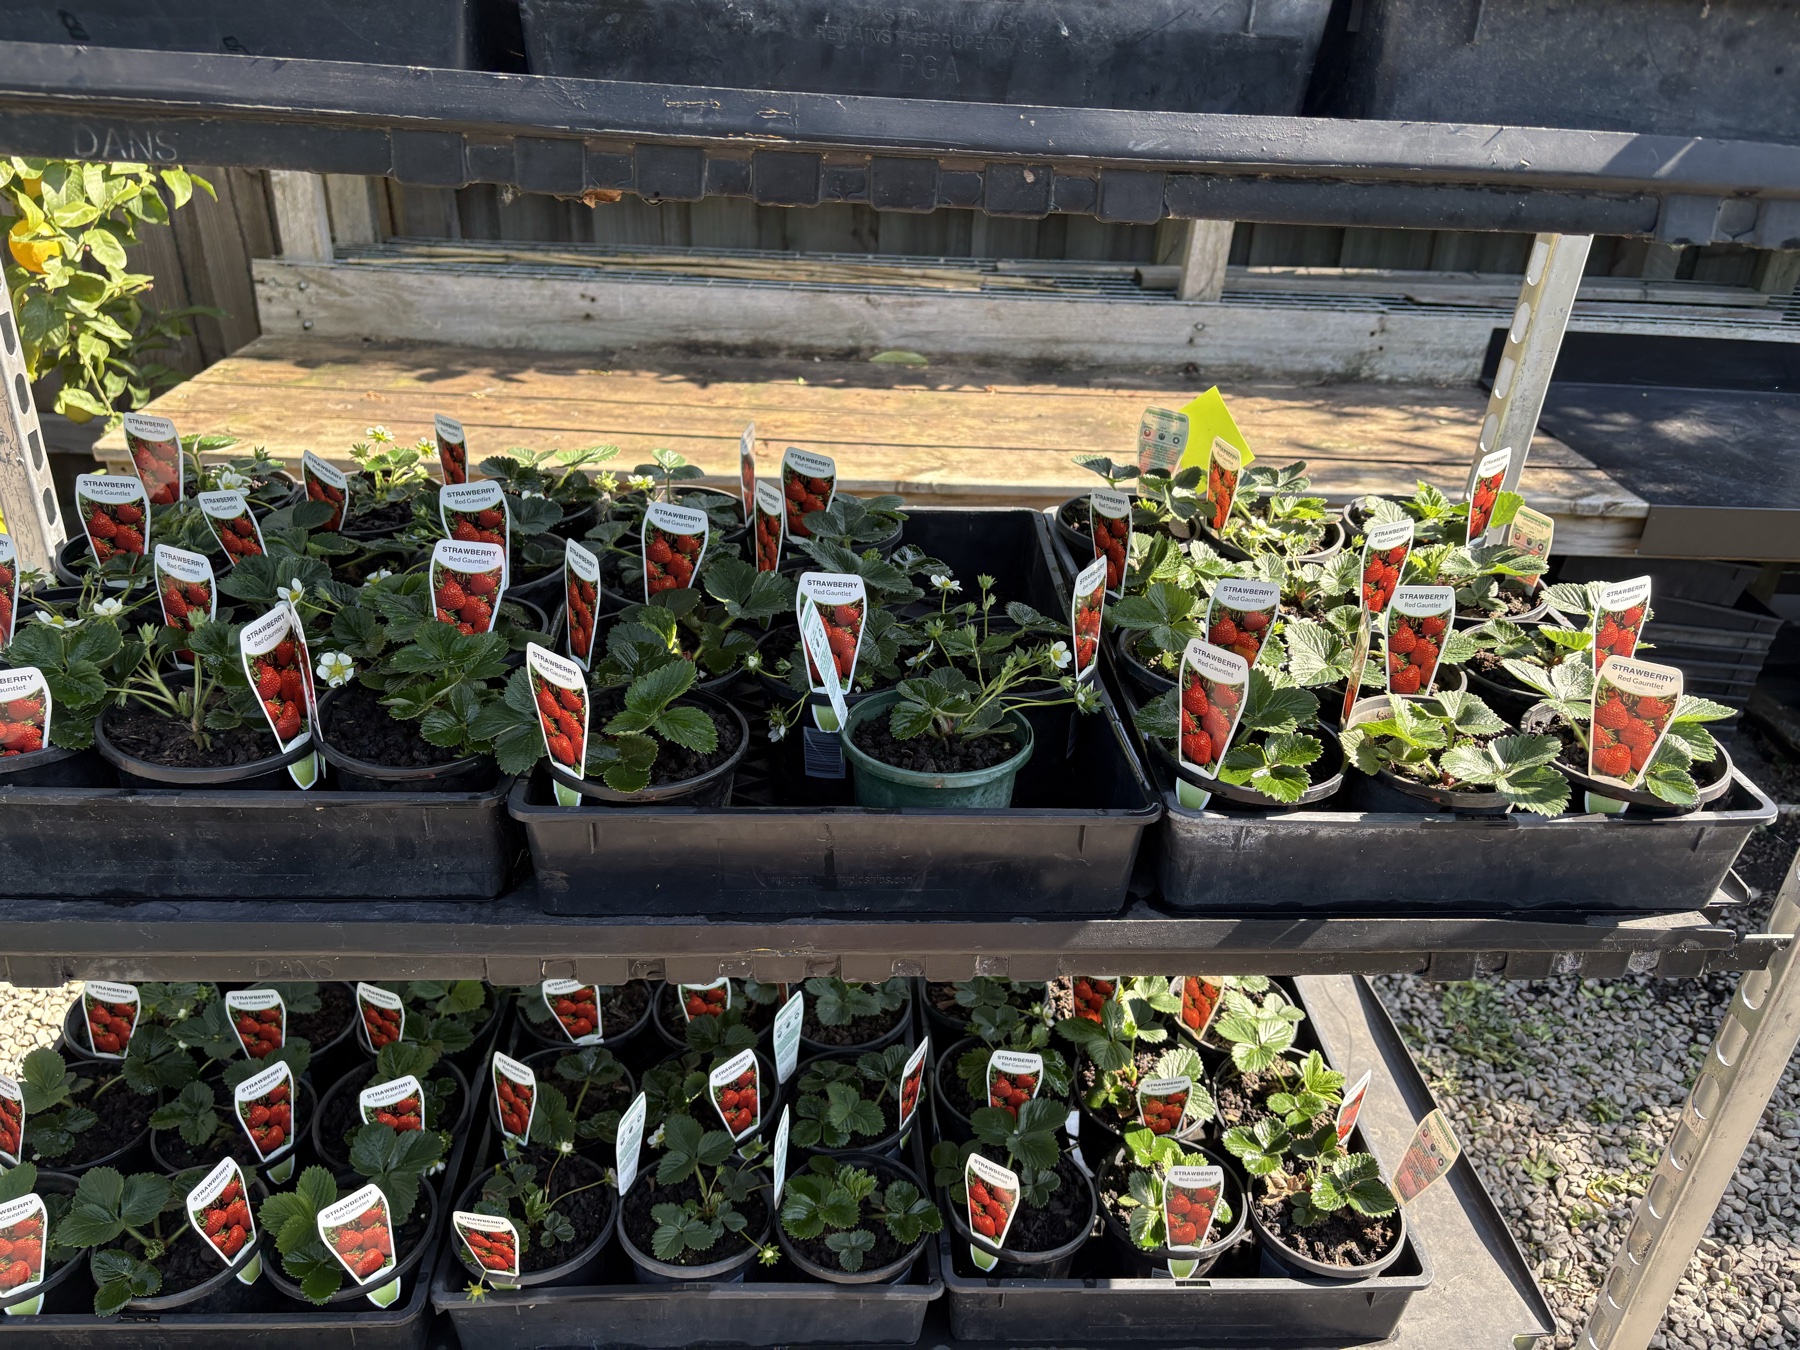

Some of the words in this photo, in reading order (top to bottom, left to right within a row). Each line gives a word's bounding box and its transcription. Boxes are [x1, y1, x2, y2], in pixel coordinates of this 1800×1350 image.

[814, 24, 893, 44] REMAINS
[932, 31, 1017, 51] PROPERTY
[900, 53, 960, 83] PGA
[73, 124, 178, 161] DANS
[128, 418, 170, 429] STRAWBERRY
[790, 452, 831, 468] STRAWBERRY
[308, 456, 342, 480] STRAWBERRY
[804, 463, 824, 474] Gauntlet
[83, 480, 136, 489] STRAWBERRY
[202, 496, 238, 504] STRAWBERRY
[446, 488, 495, 498] STRAWBERRY
[466, 496, 491, 504] Gauntlet
[1094, 494, 1126, 506] STRAWBERRY
[654, 508, 702, 523] STRAWBERRY
[671, 520, 695, 530] Gauntlet
[1374, 526, 1410, 538] STRAWBERRY
[1386, 534, 1404, 542] Gauntlet
[442, 546, 497, 557] STRAWBERRY
[569, 546, 596, 570] STRAWBERRY
[160, 552, 204, 568] STRAWBERRY
[462, 558, 490, 566] Gauntlet
[178, 564, 200, 576] Gauntlet
[807, 580, 858, 588] STRAWBERRY
[1222, 586, 1274, 596] STRAWBERRY
[1606, 584, 1646, 598] STRAWBERRY
[1240, 596, 1266, 604] Gauntlet
[1620, 594, 1640, 603] Gauntlet
[246, 612, 286, 642] STRAWBERRY
[254, 638, 264, 648] Red
[264, 626, 284, 644] Gauntlet
[532, 651, 576, 676] STRAWBERRY
[1192, 647, 1242, 671] STRAWBERRY
[539, 662, 550, 672] Red
[550, 668, 572, 684] Gauntlet
[1198, 658, 1208, 668] Red
[1208, 663, 1234, 678] Gauntlet
[1612, 664, 1676, 684] STRAWBERRY
[0, 674, 34, 685] BERRY
[1618, 674, 1632, 682] Red
[1632, 677, 1664, 690] Gauntlet
[0, 684, 26, 693] auntlet
[255, 958, 334, 979] DANS
[91, 984, 133, 994] STRAWBERRY
[498, 1057, 530, 1076] STRAWBERRY
[715, 1054, 750, 1079] STRAWBERRY
[997, 1055, 1038, 1064] STRAWBERRY
[242, 1066, 283, 1093] STRAWBERRY
[258, 1076, 280, 1092] Gauntlet
[1146, 1080, 1186, 1088] STRAWBERRY
[366, 1080, 412, 1099] STRAWBERRY
[385, 1088, 408, 1100] Gauntlet
[974, 1159, 1014, 1181] STRAWBERRY
[988, 1170, 1008, 1185] Gauntlet
[193, 1162, 230, 1202] STRAWBERRY
[200, 1192, 210, 1203] Red
[210, 1174, 229, 1194] Gauntlet
[0, 1200, 34, 1214] WBERRY
[324, 1189, 374, 1220] STRAWBERRY
[334, 1212, 346, 1222] Red
[346, 1199, 370, 1216] Gauntlet
[460, 1216, 504, 1225] STRAWBERRY
